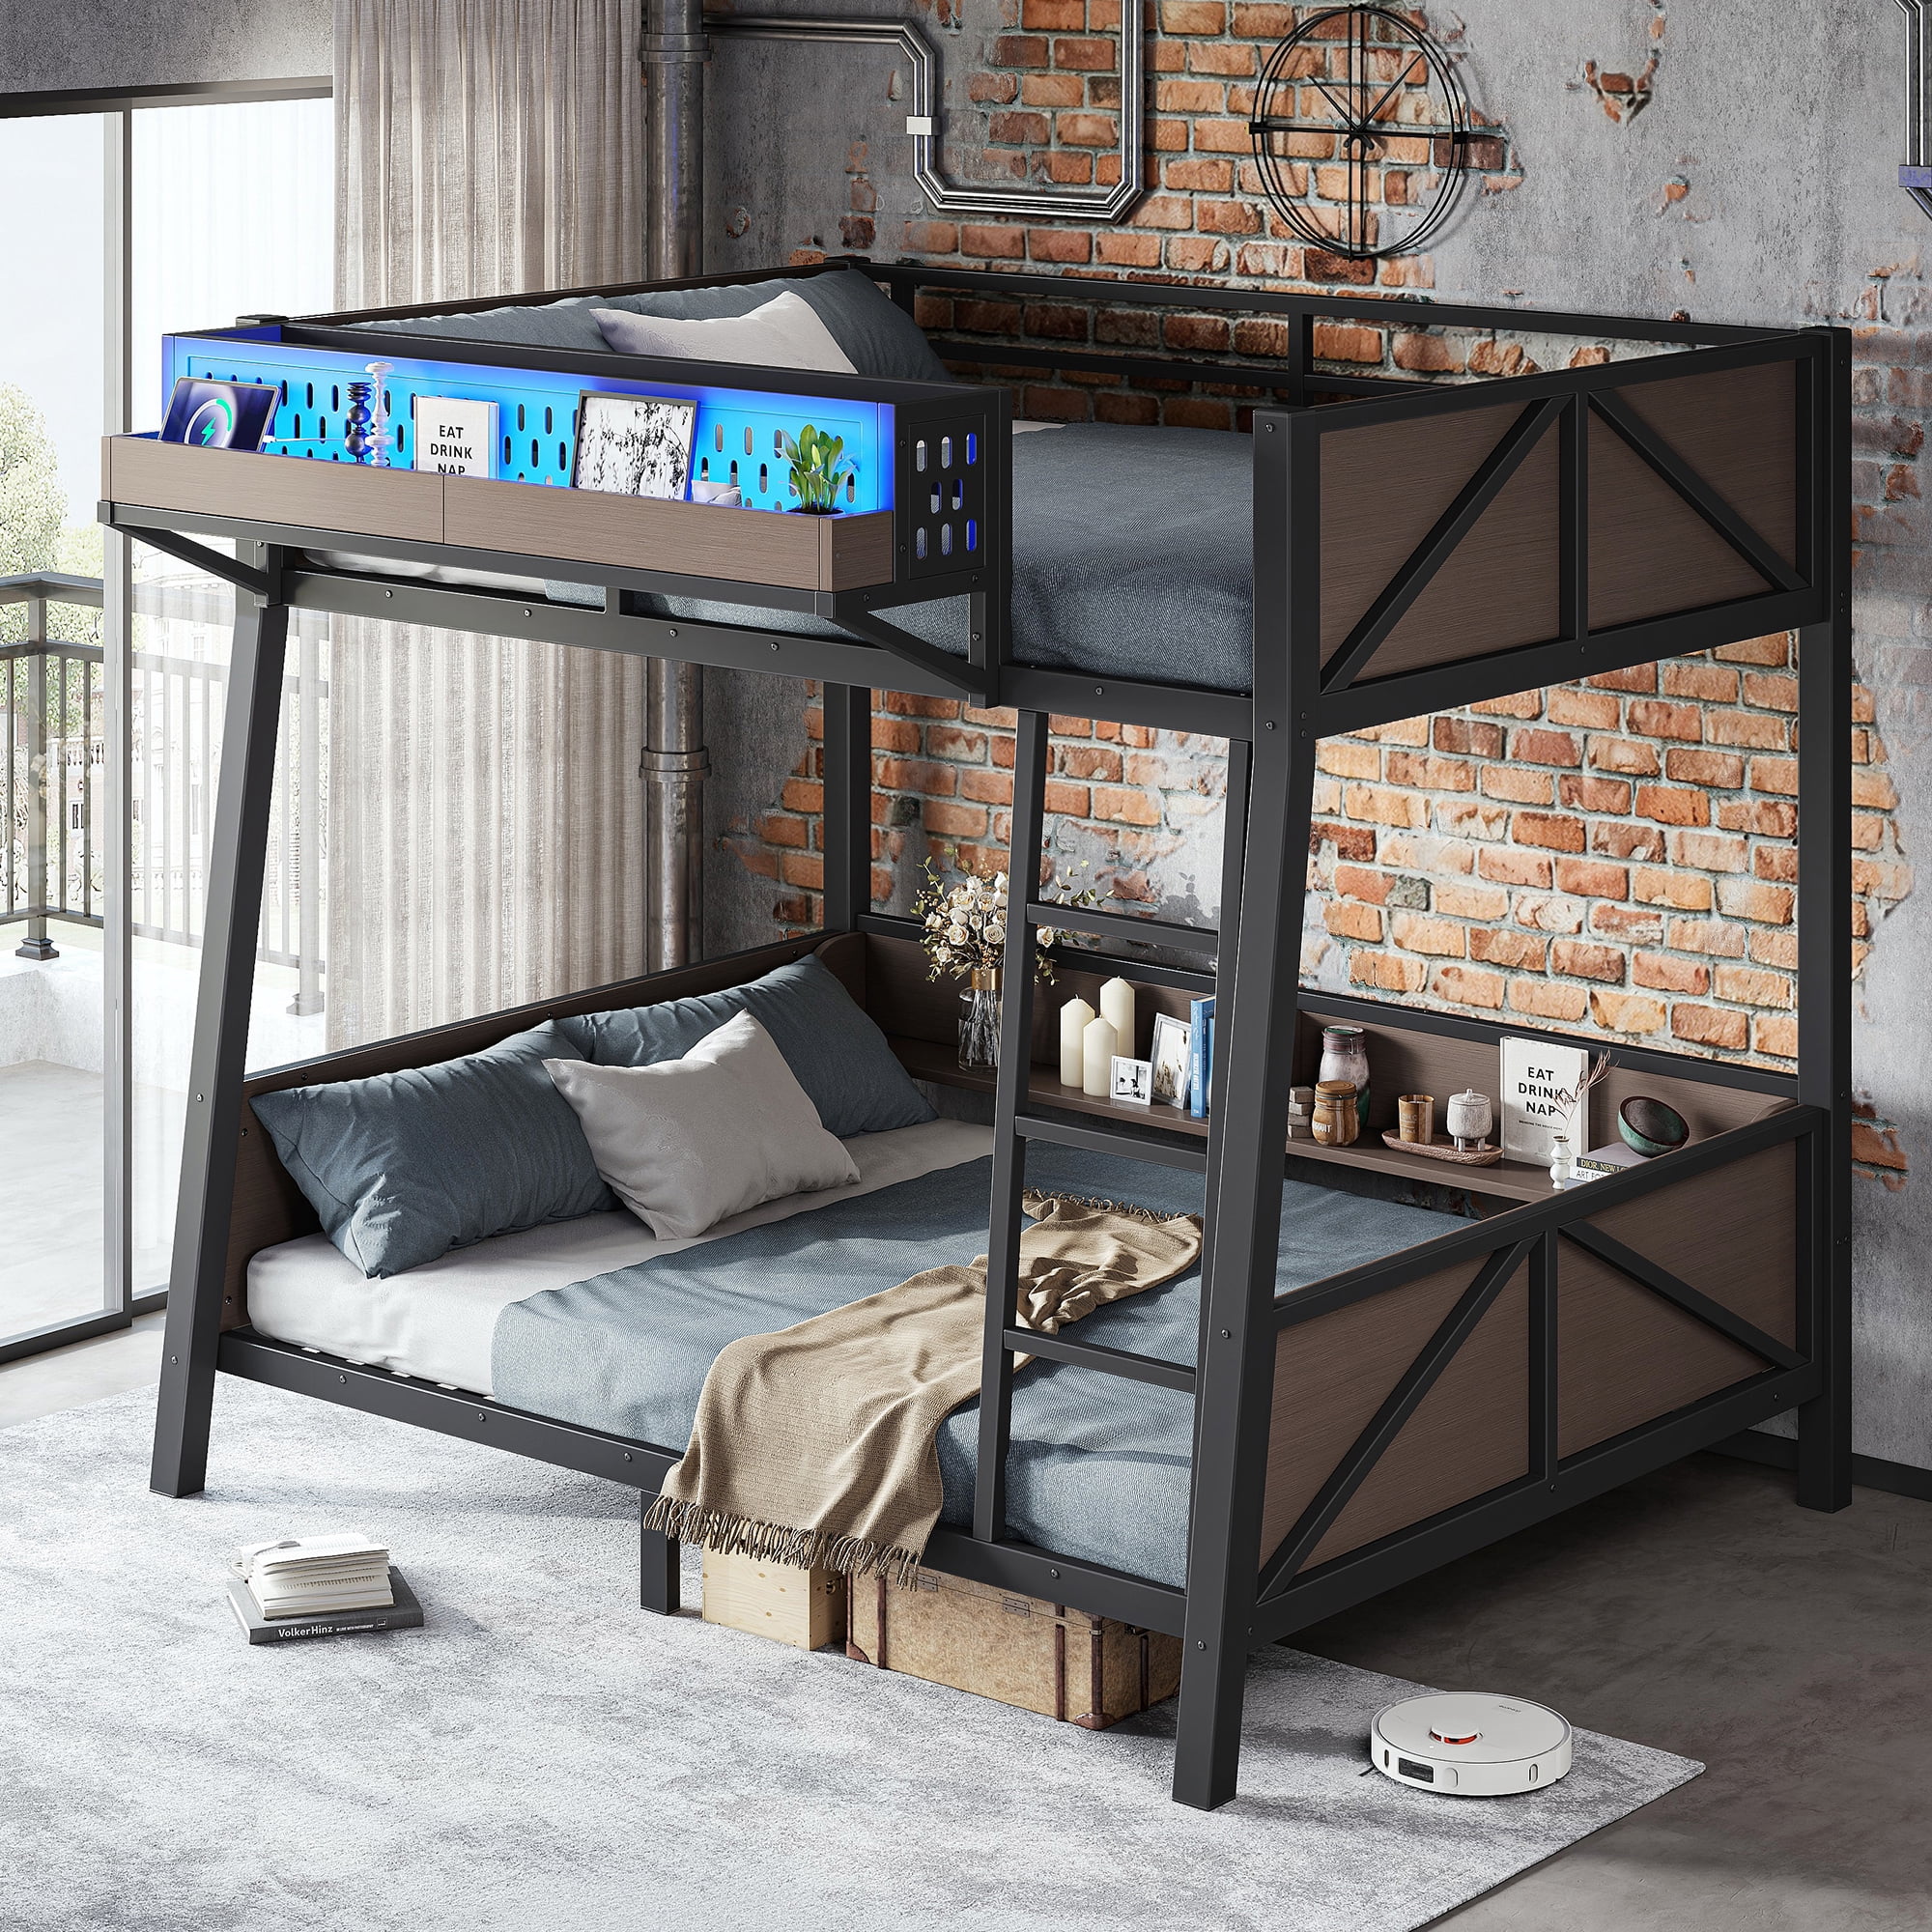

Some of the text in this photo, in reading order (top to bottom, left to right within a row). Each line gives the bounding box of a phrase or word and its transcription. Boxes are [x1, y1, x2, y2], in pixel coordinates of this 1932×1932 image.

[439, 425, 464, 439] EAT
[430, 443, 472, 460] DRINK
[438, 463, 466, 475] NAP
[1527, 1066, 1554, 1081] EAT
[1518, 1082, 1564, 1101] DRINK
[1525, 1100, 1556, 1117] NAP
[1576, 1170, 1589, 1179] ART
